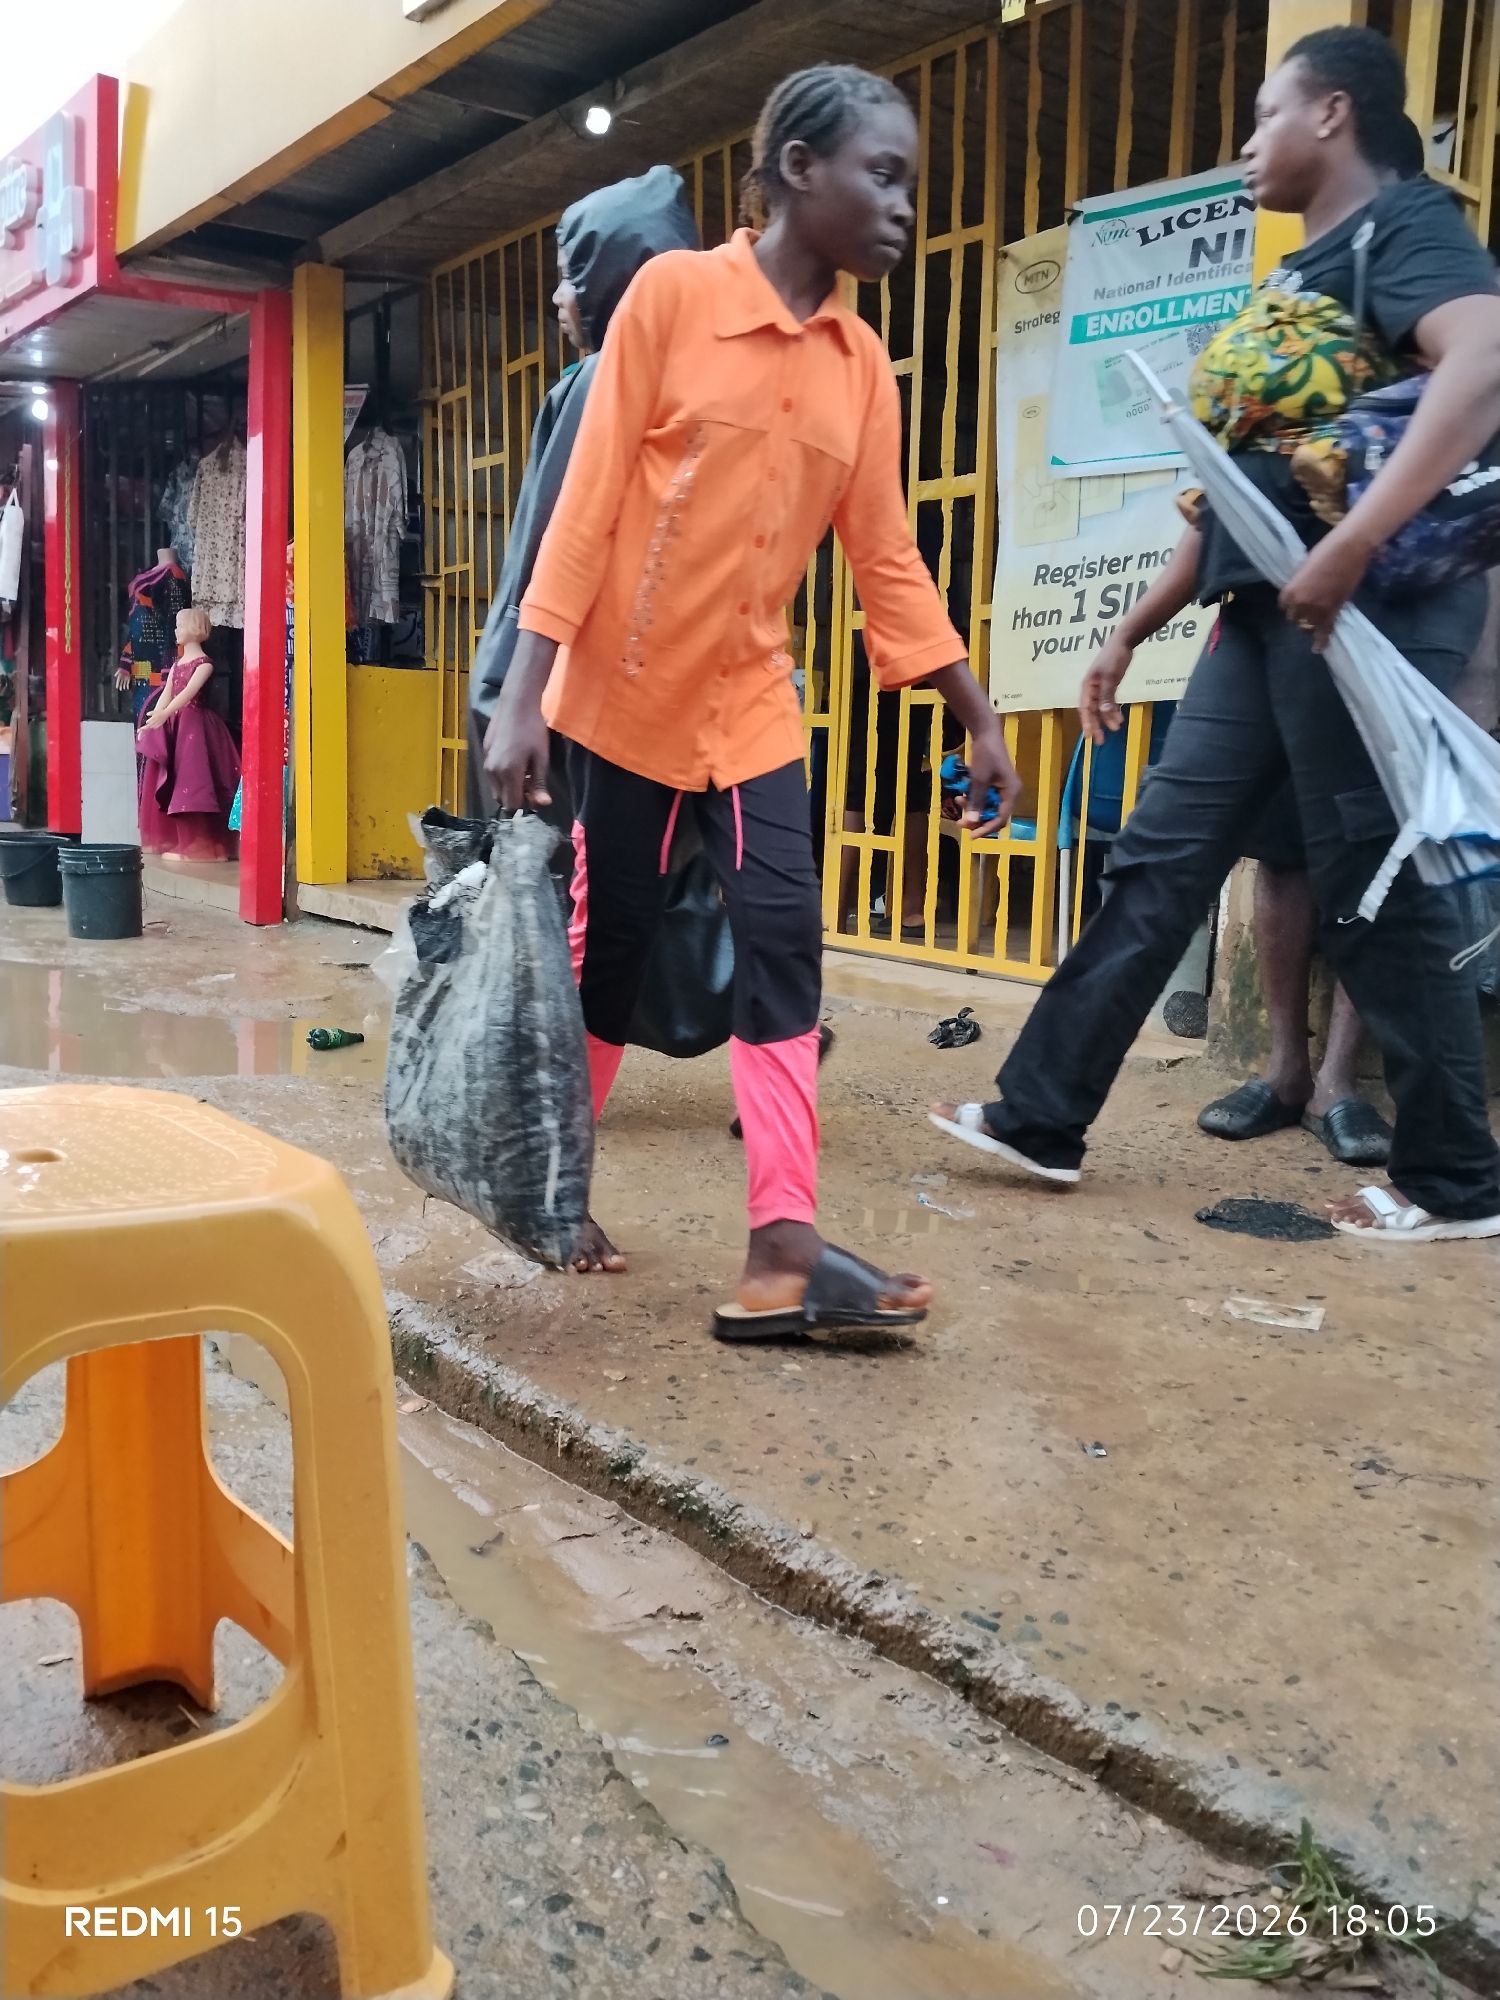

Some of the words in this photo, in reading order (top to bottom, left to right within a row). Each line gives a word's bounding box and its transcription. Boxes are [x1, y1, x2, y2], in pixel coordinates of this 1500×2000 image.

[1136, 194, 1257, 247] LICEN
[1188, 227, 1255, 269] NI
[1024, 268, 1050, 287] MTN
[1093, 275, 1162, 301] National
[1033, 554, 1133, 588] Register
[1012, 606, 1063, 631] than
[1070, 589, 1087, 624] 1
[1031, 634, 1085, 662] your
